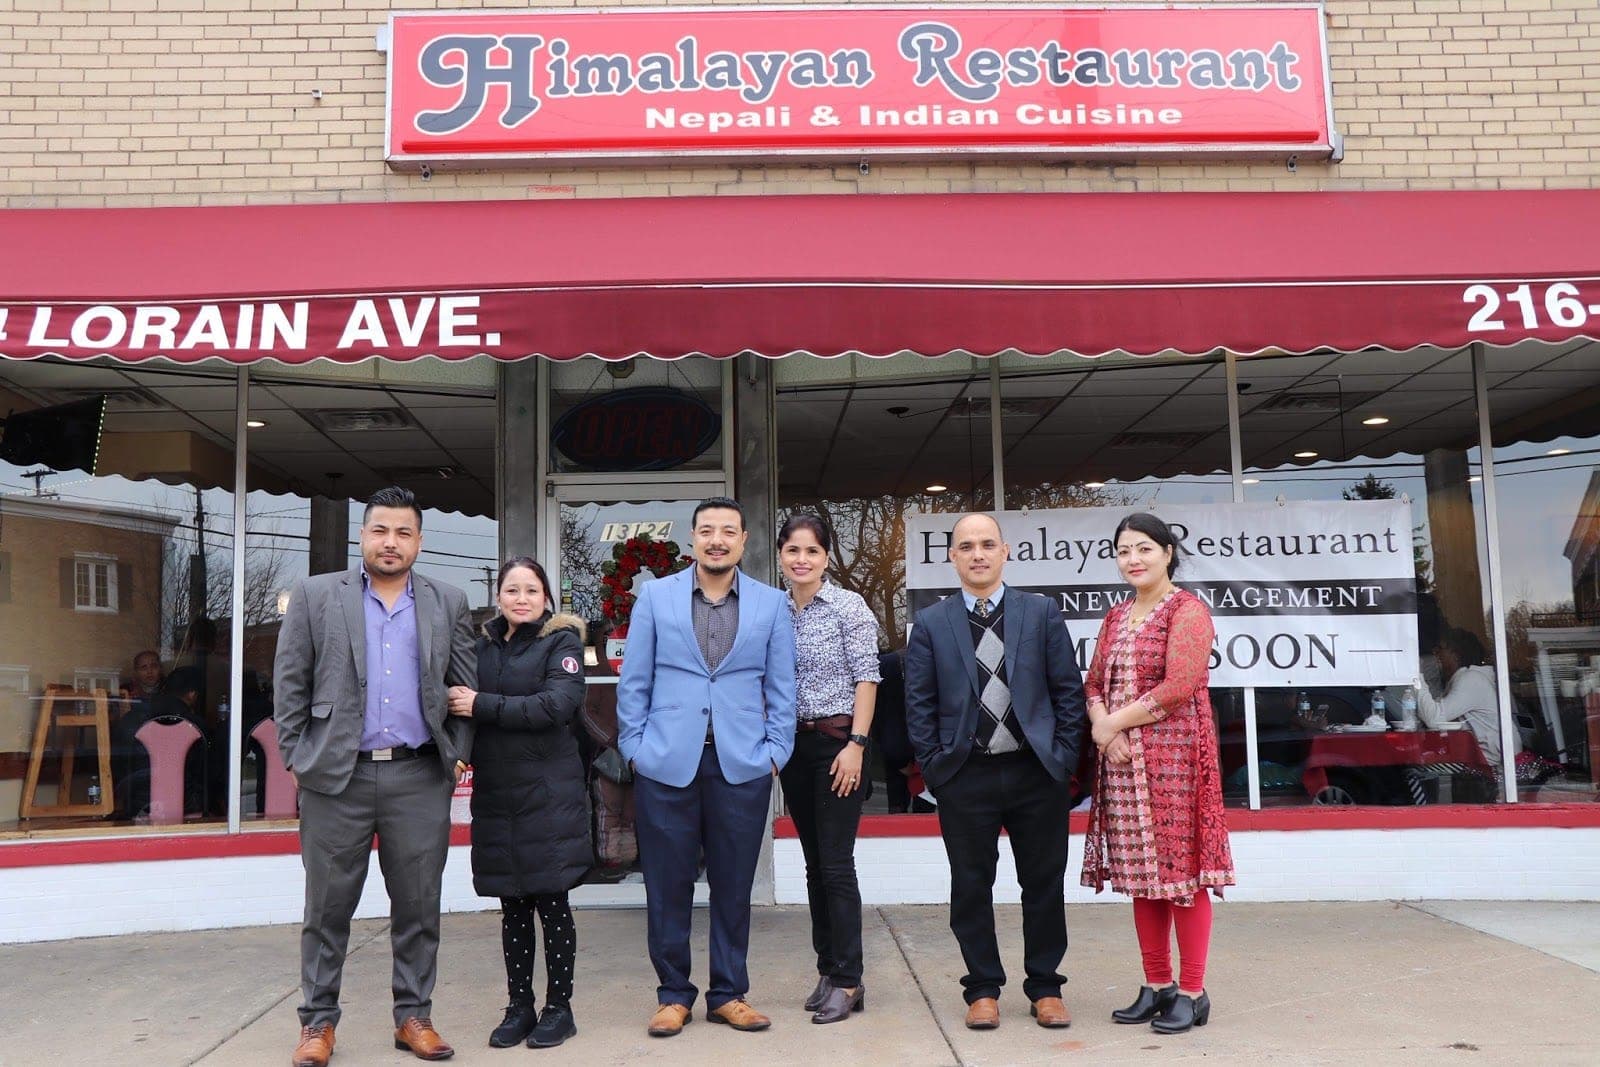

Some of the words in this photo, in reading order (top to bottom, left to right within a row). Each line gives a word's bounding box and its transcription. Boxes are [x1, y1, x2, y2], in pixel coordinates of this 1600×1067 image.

[414, 34, 876, 135] Himalayan
[899, 22, 1302, 102] Restaurant
[645, 106, 791, 133] Nepali
[809, 105, 840, 127] &
[860, 105, 999, 126] Indian
[1015, 103, 1183, 125] Cuisine
[26, 302, 309, 349] LORAIN
[338, 296, 501, 348] AVE.
[573, 401, 703, 458] OPEN
[606, 522, 671, 541] 13124
[920, 527, 1118, 574] Halaya
[1166, 523, 1398, 558] Restaurant
[1060, 590, 1132, 612] NEW
[1196, 586, 1382, 610] NAGEMENT
